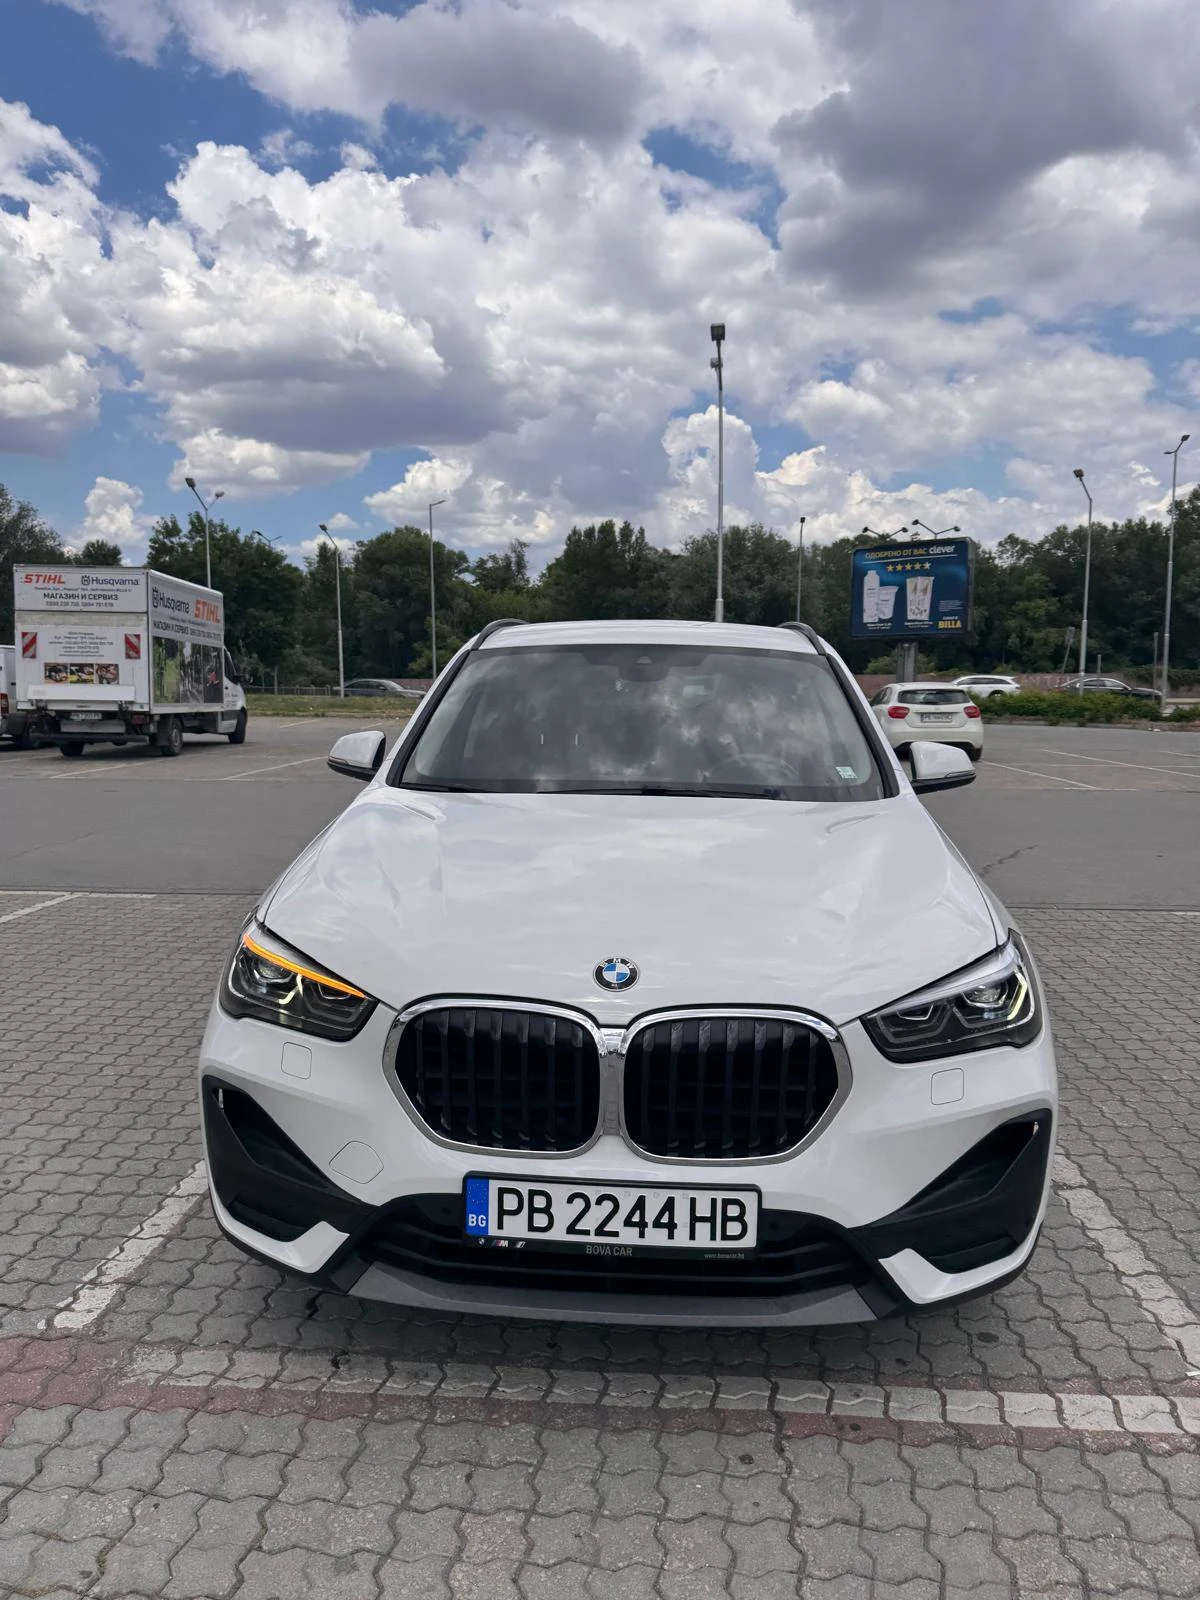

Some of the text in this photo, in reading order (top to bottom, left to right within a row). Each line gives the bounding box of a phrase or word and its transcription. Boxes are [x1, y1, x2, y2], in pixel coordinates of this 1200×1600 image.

[865, 550, 902, 561] ОДОБРЕНО
[929, 545, 956, 554] clever
[24, 573, 66, 585] STIHL
[91, 576, 140, 587] Husqvarna
[43, 592, 80, 600] МАГАЗИН
[88, 593, 119, 601] СЕРВИЗ
[159, 591, 190, 614] Husqvarna
[194, 599, 221, 624] STIHL
[938, 620, 962, 629] BILLA
[468, 1213, 487, 1228] BG
[496, 1186, 749, 1242] PB 2244 HB
[586, 1244, 633, 1257] BOVA CAR
